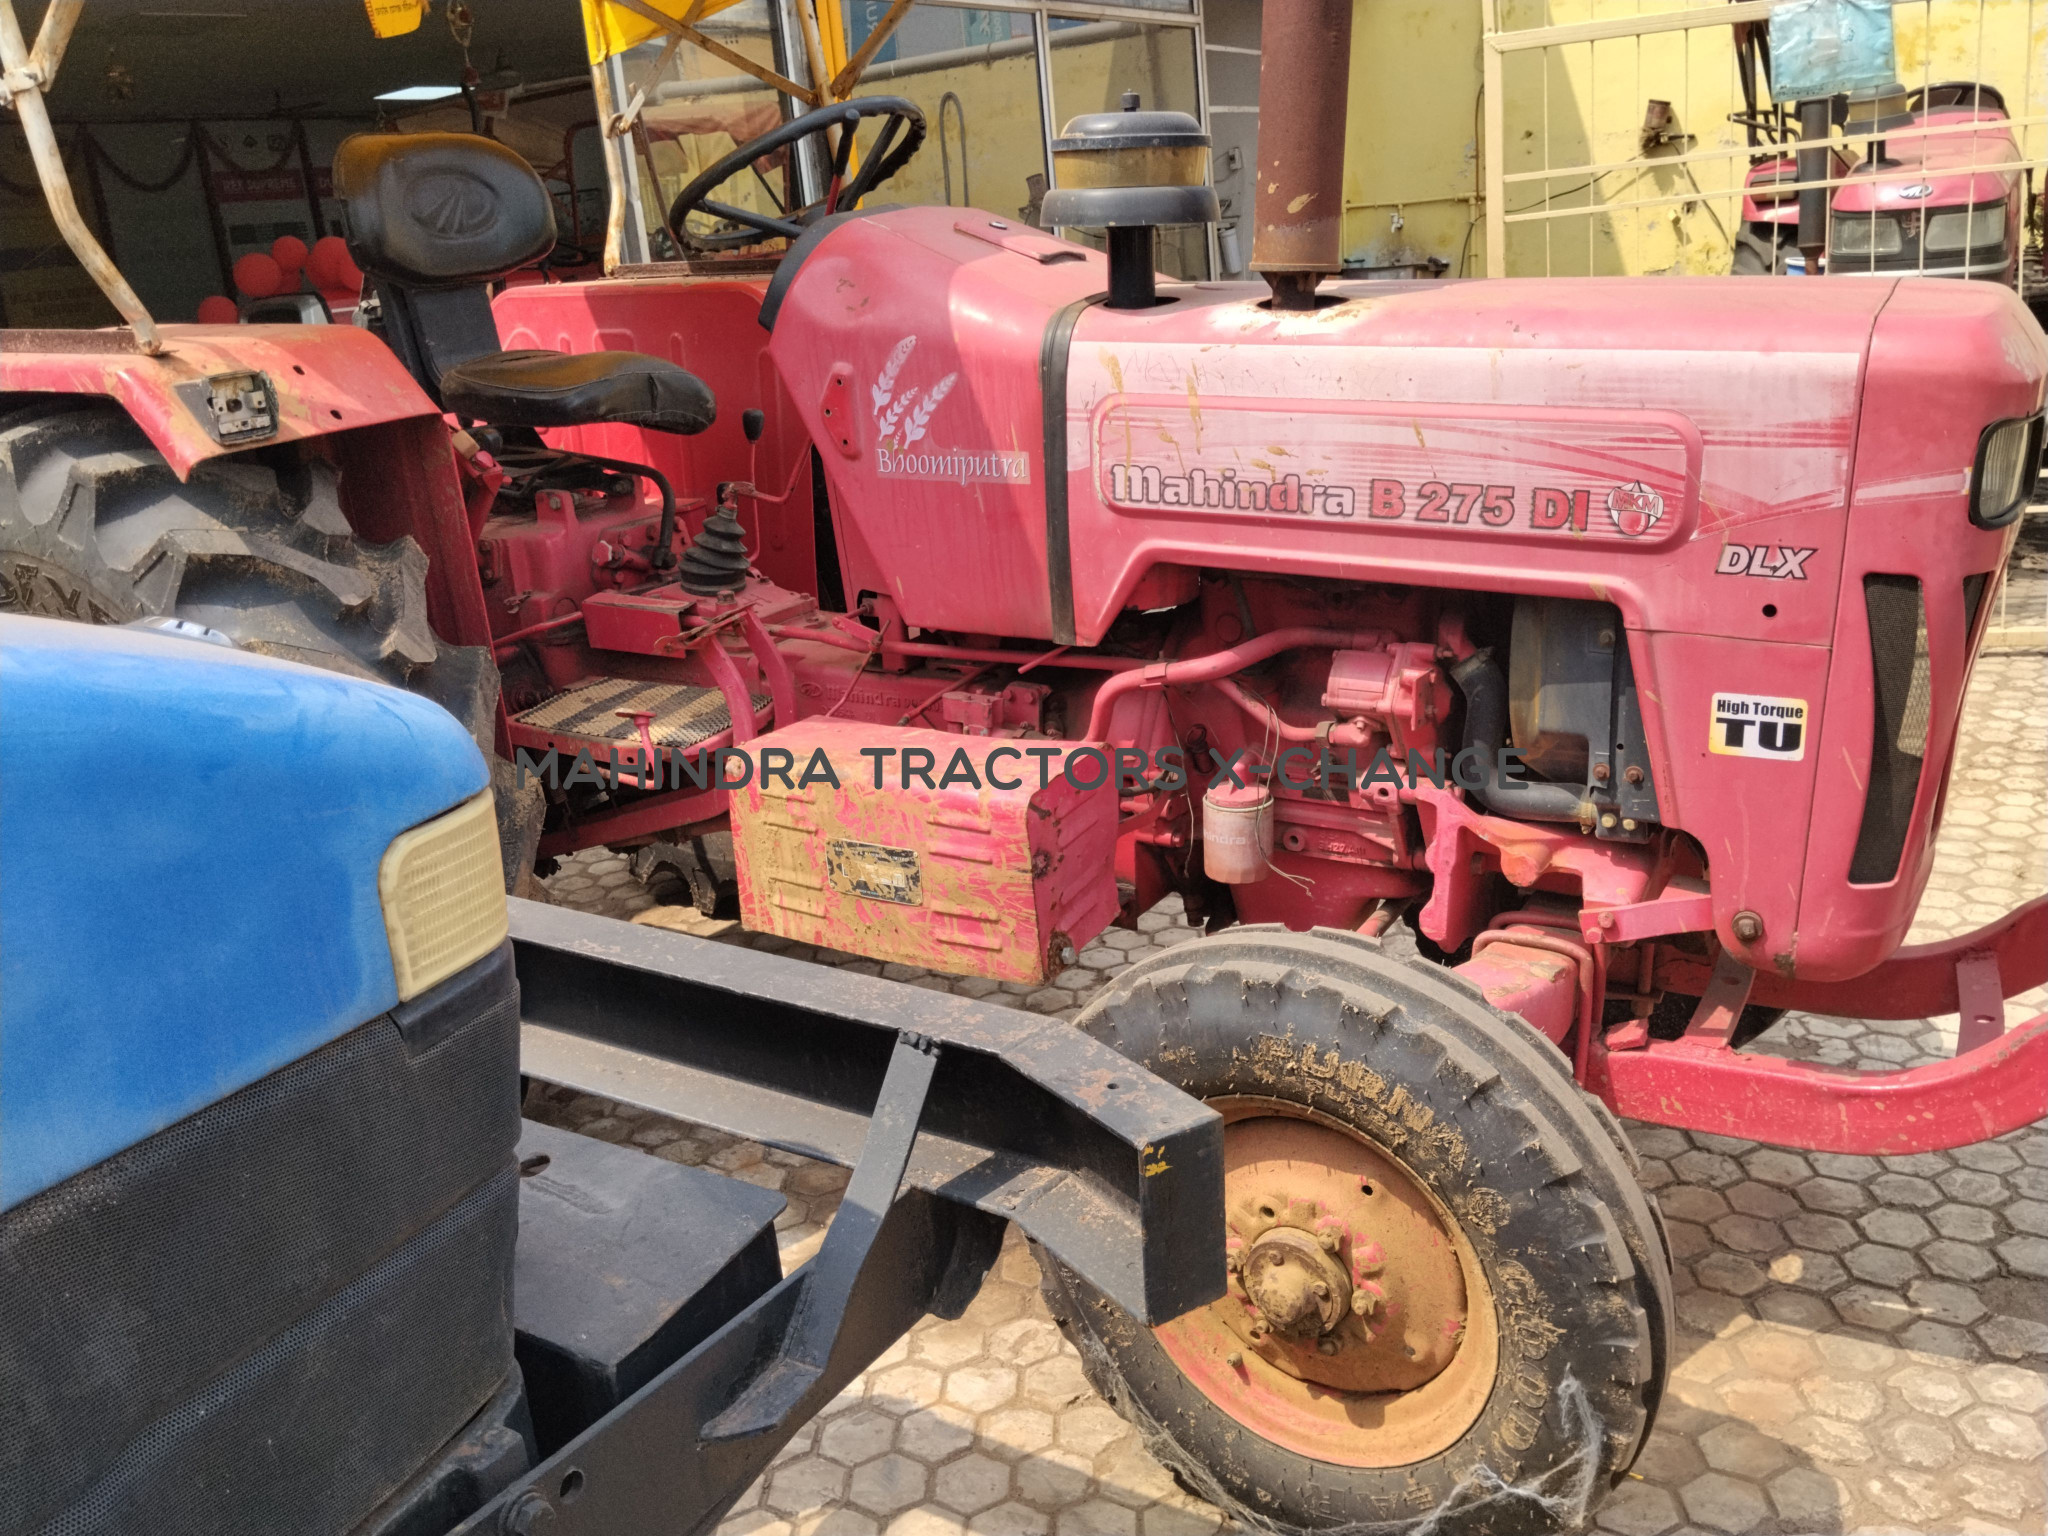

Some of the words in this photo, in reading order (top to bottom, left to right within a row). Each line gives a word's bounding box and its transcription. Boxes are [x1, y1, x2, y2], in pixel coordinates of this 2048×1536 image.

[877, 448, 1028, 486] Bhoomiputra
[1111, 464, 1355, 516] Mahindra
[1369, 478, 1405, 519] B
[1416, 481, 1515, 526] 275
[1530, 487, 1591, 531] DI
[1716, 542, 1819, 580] DLX
[1716, 699, 1749, 715] High
[1752, 702, 1804, 718] Torque
[1715, 717, 1803, 752] TU
